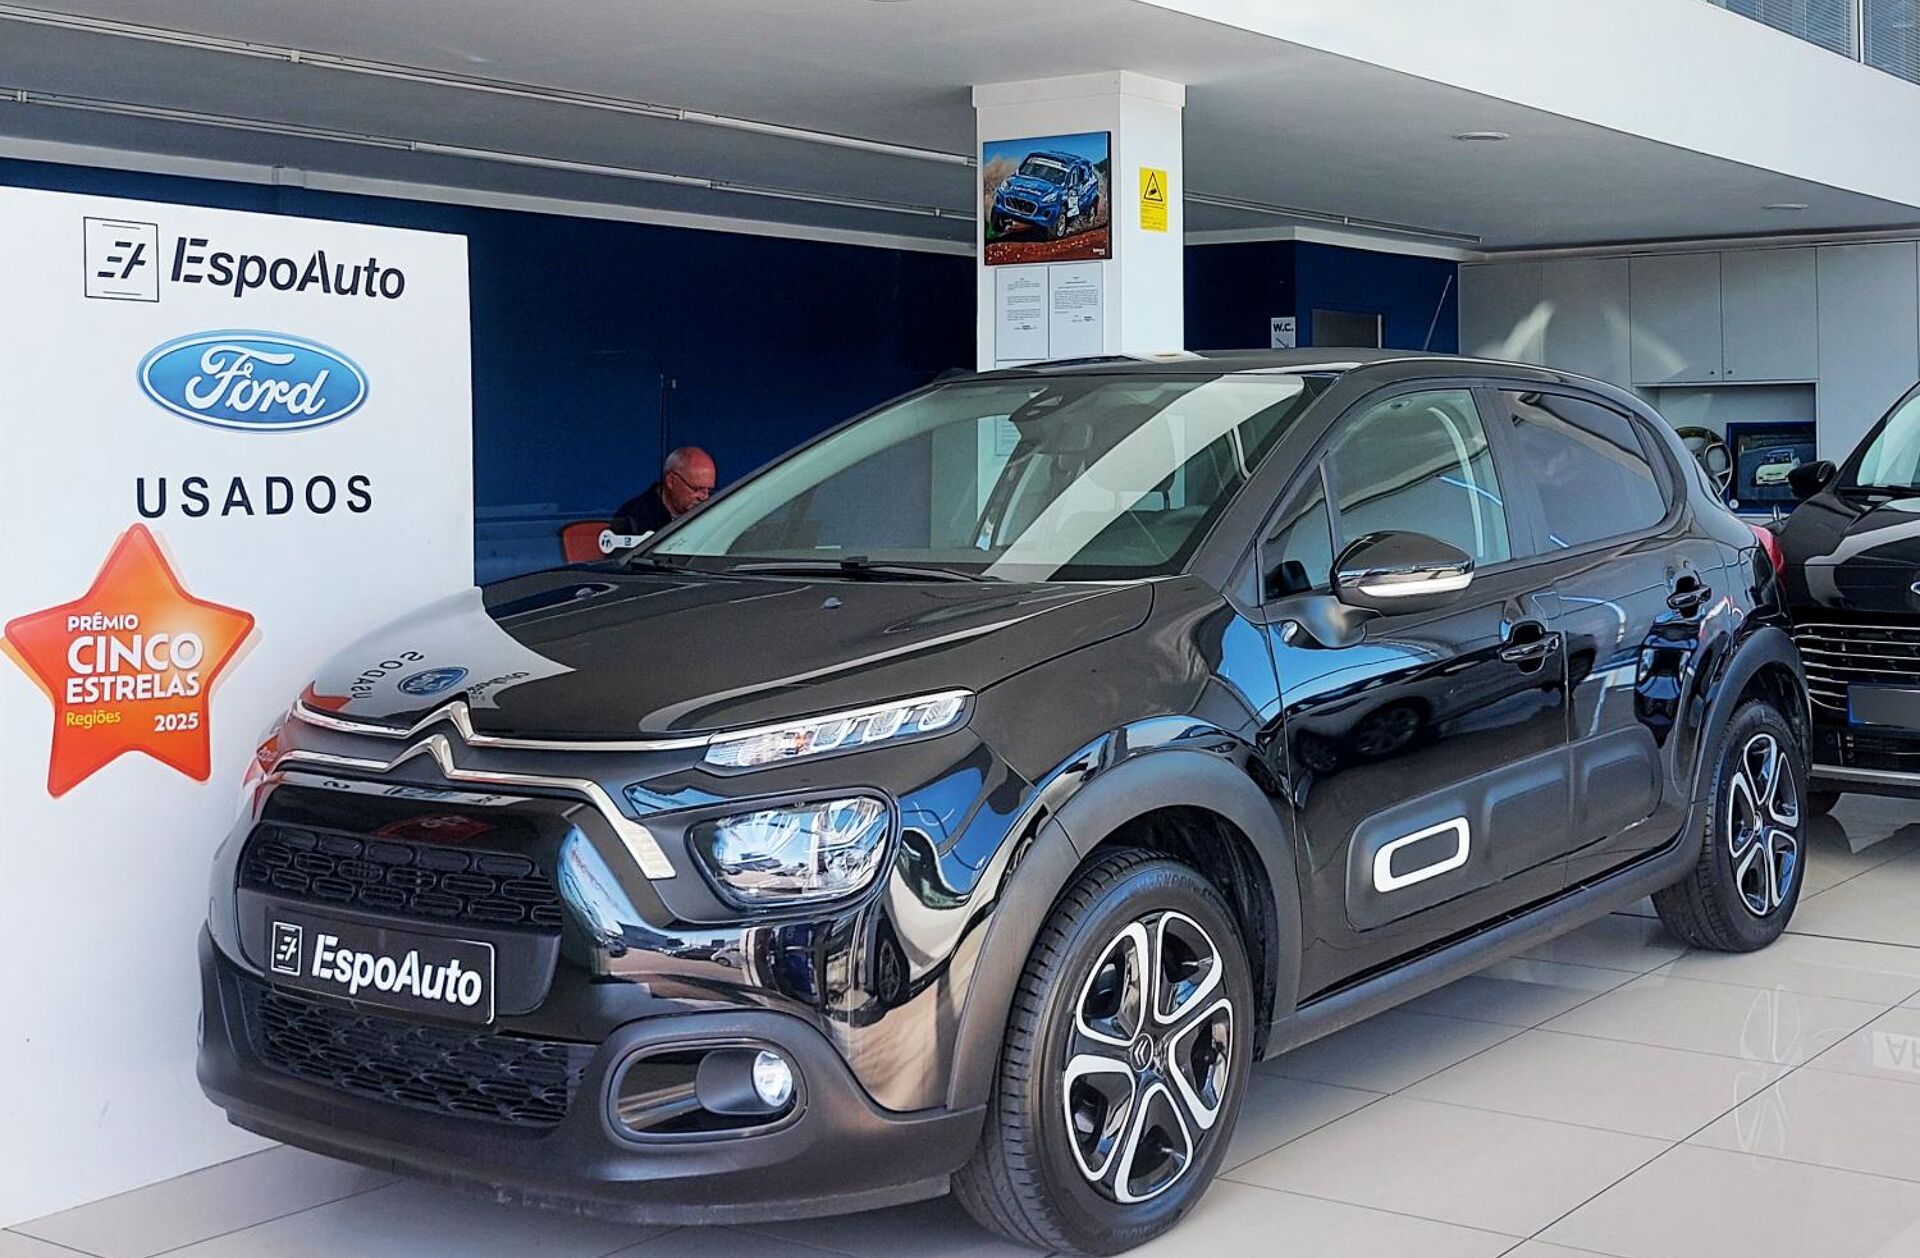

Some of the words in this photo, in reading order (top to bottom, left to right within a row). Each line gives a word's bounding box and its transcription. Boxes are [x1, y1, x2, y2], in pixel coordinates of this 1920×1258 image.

[170, 237, 406, 299] EspoAuto
[1273, 323, 1294, 332] W.C.
[184, 344, 329, 415] Ford
[136, 475, 372, 518] USADOS
[68, 611, 138, 631] PRÉMIO
[67, 632, 202, 674] CINCO
[66, 672, 200, 703] ESTRELAS
[66, 709, 121, 728] Regiões
[154, 712, 199, 732] 2025
[312, 934, 482, 1006] EspoAuto
